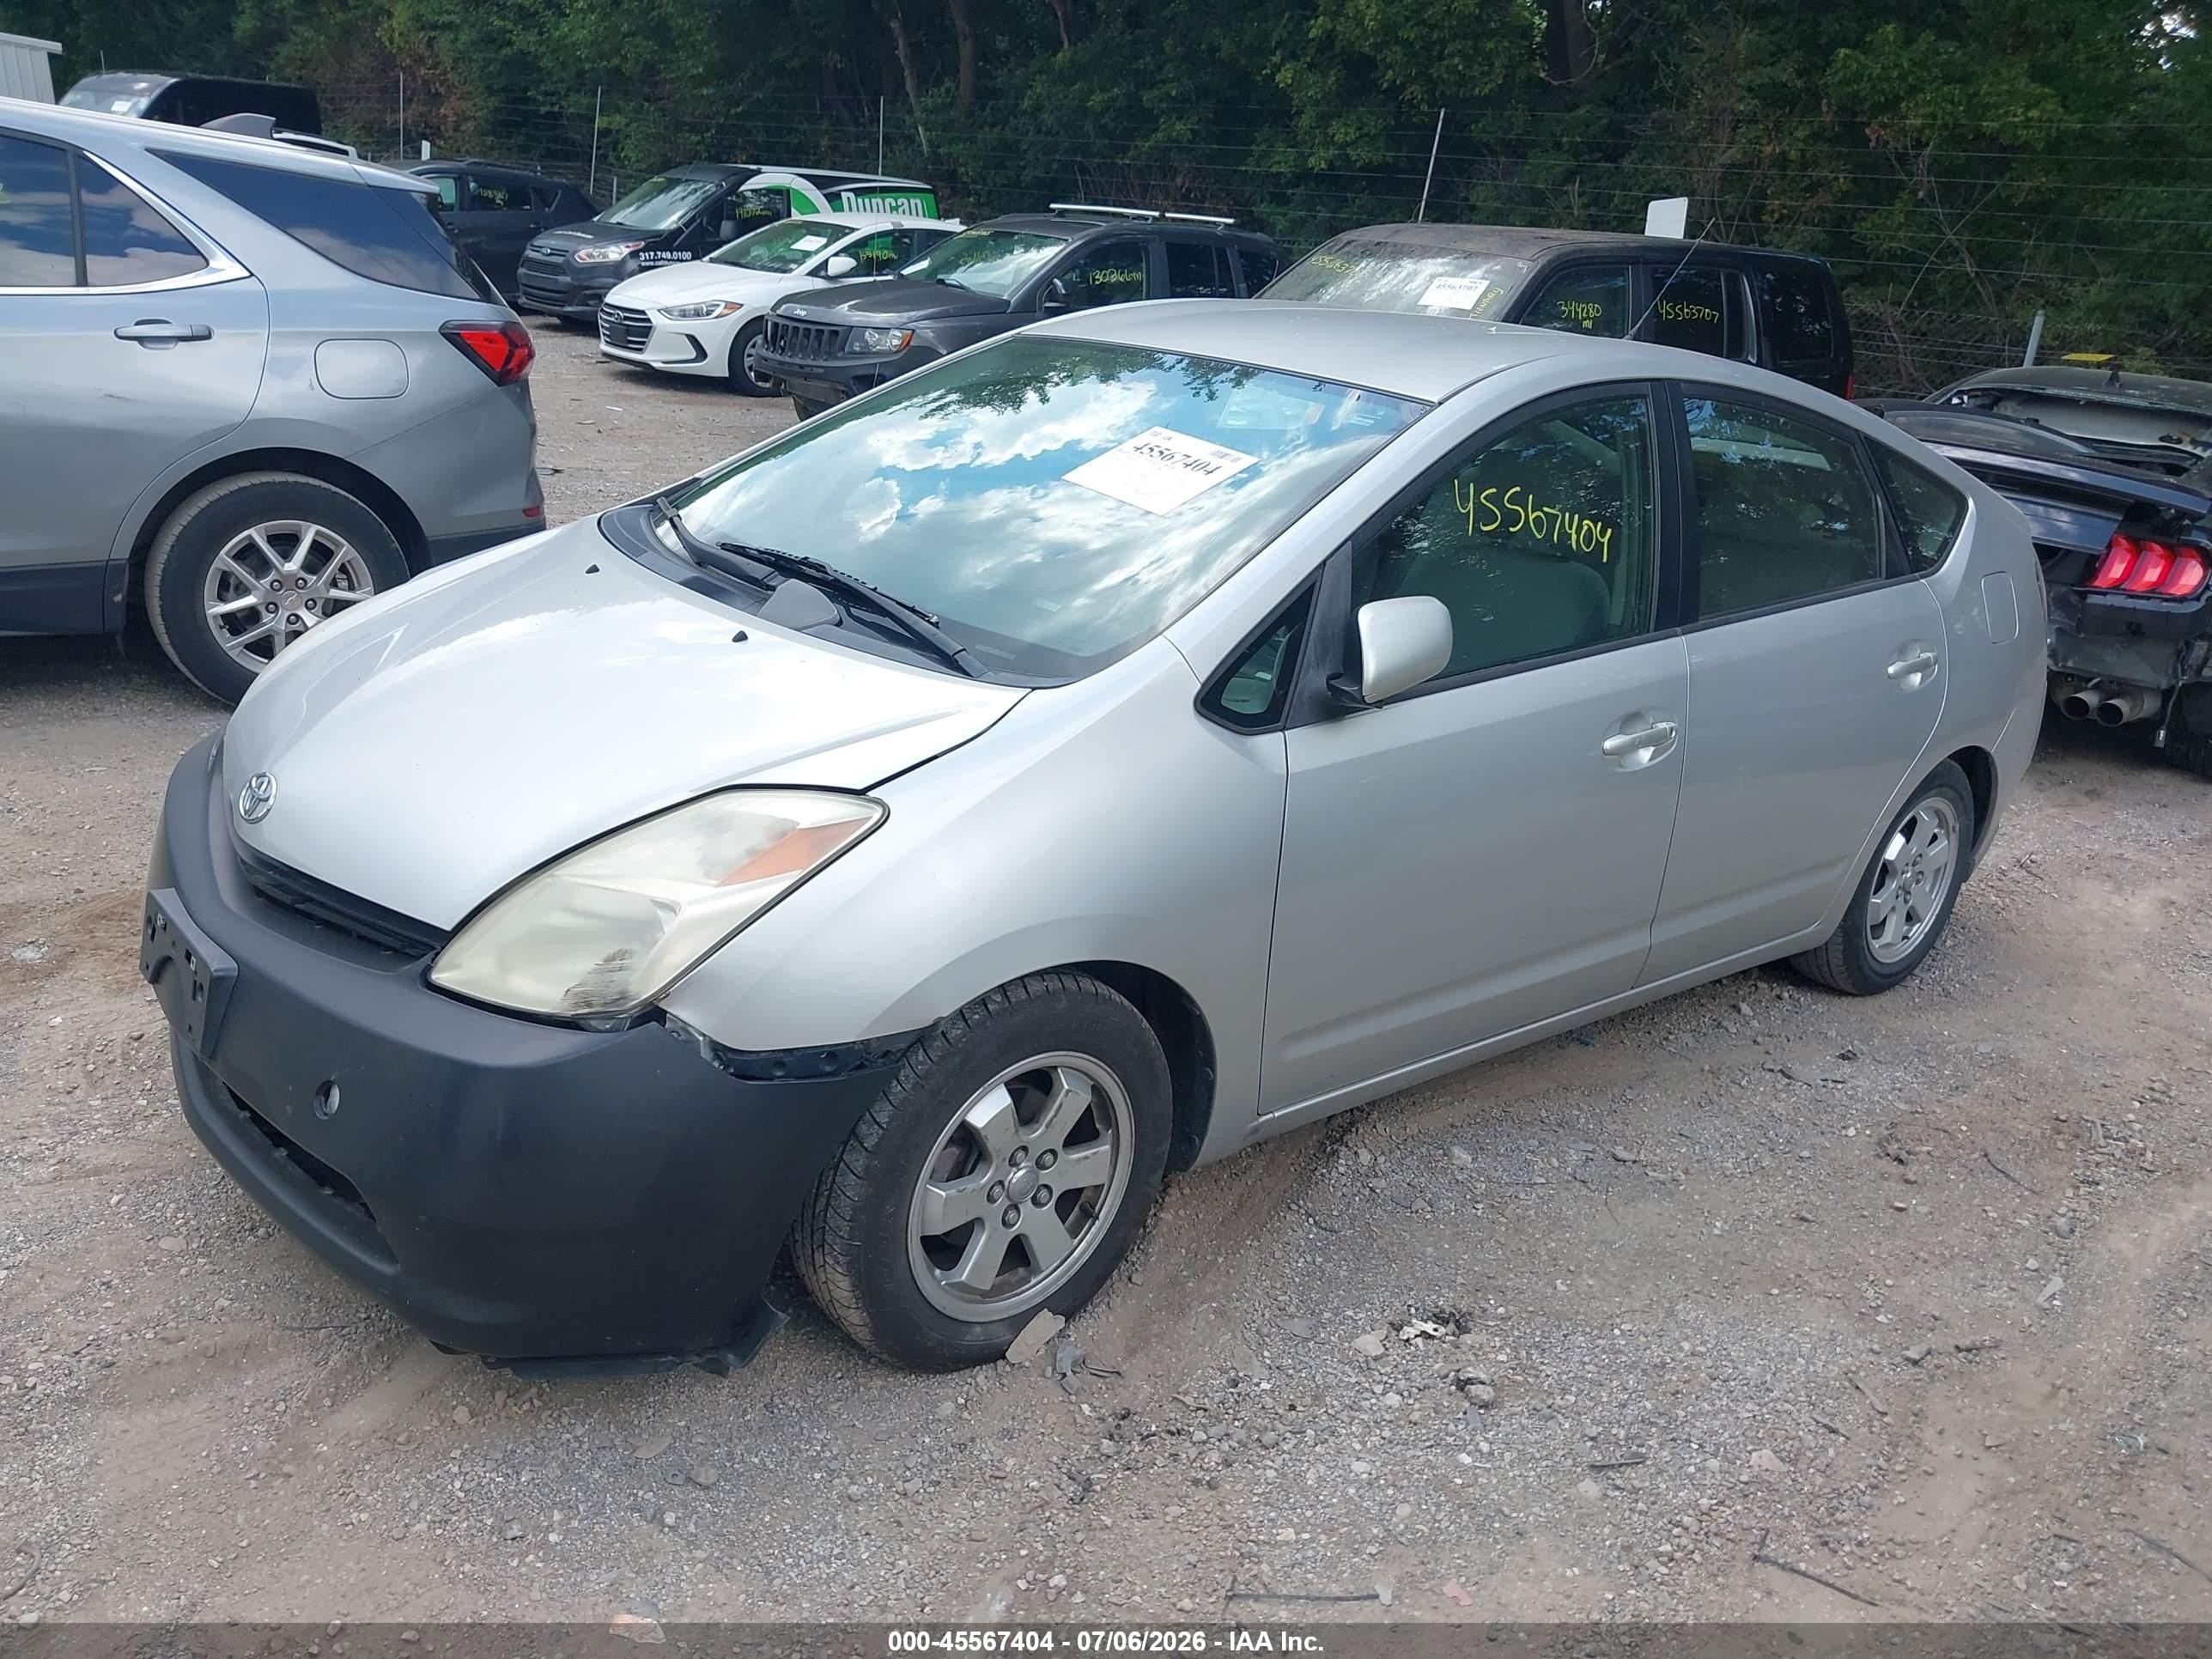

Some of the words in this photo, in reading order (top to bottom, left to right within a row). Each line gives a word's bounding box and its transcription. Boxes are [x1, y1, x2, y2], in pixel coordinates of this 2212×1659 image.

[841, 191, 923, 217] Duncan
[638, 251, 692, 261] 317.749.0100
[1556, 301, 1602, 320] 344280
[1657, 300, 1720, 324] 45563707
[1133, 441, 1224, 477] 45567404
[1454, 478, 1613, 564] 45567404
